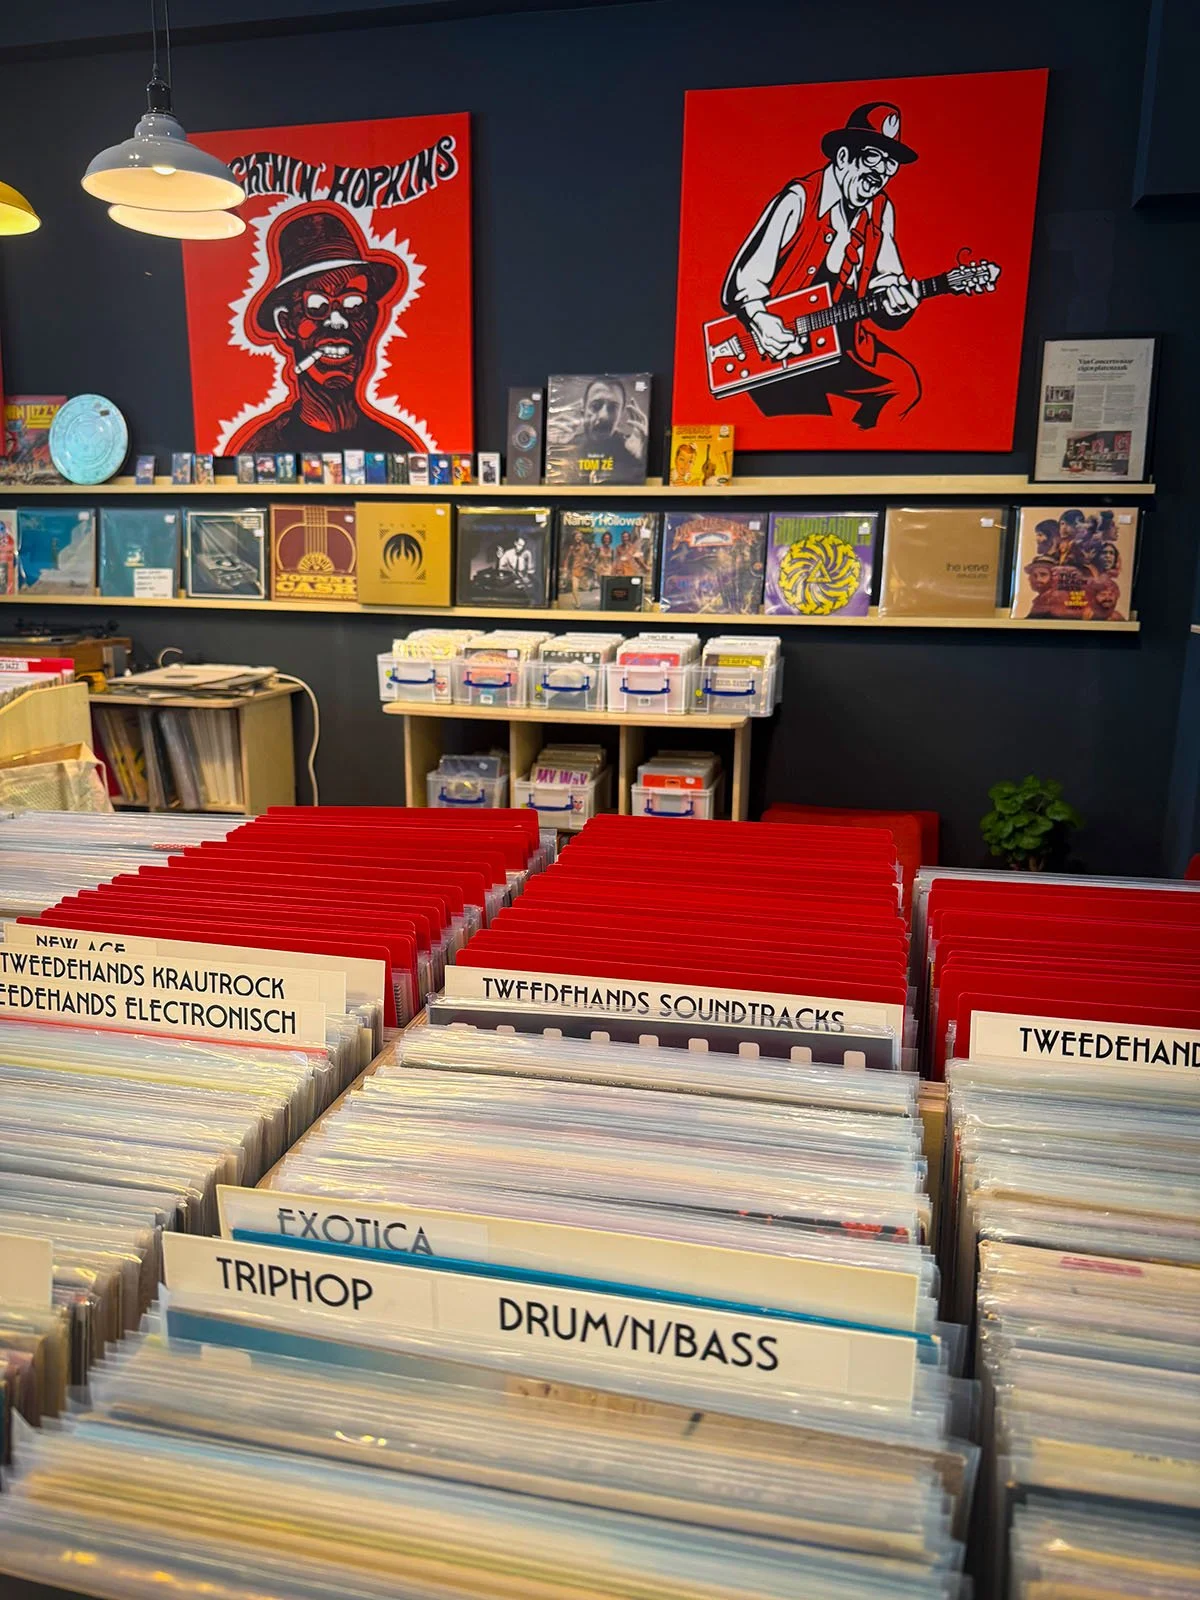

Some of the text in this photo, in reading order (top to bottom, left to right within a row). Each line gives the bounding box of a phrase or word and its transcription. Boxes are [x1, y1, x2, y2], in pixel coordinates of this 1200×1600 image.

[325, 135, 458, 209] HOPKINS
[578, 456, 613, 471] TOM ZÉ
[563, 512, 649, 528] Nancy Holloway
[276, 581, 357, 594] CASH
[0, 952, 286, 1000] TWEEDEHANDS KRAUTROCK
[125, 996, 297, 1035] ELECTRONISCH
[483, 977, 845, 1033] TWEEDEHANDS SOUNDTRACKS
[277, 1207, 435, 1256] EXOTICA
[216, 1256, 779, 1371] TRIPHOP DRUM/N/BASS
